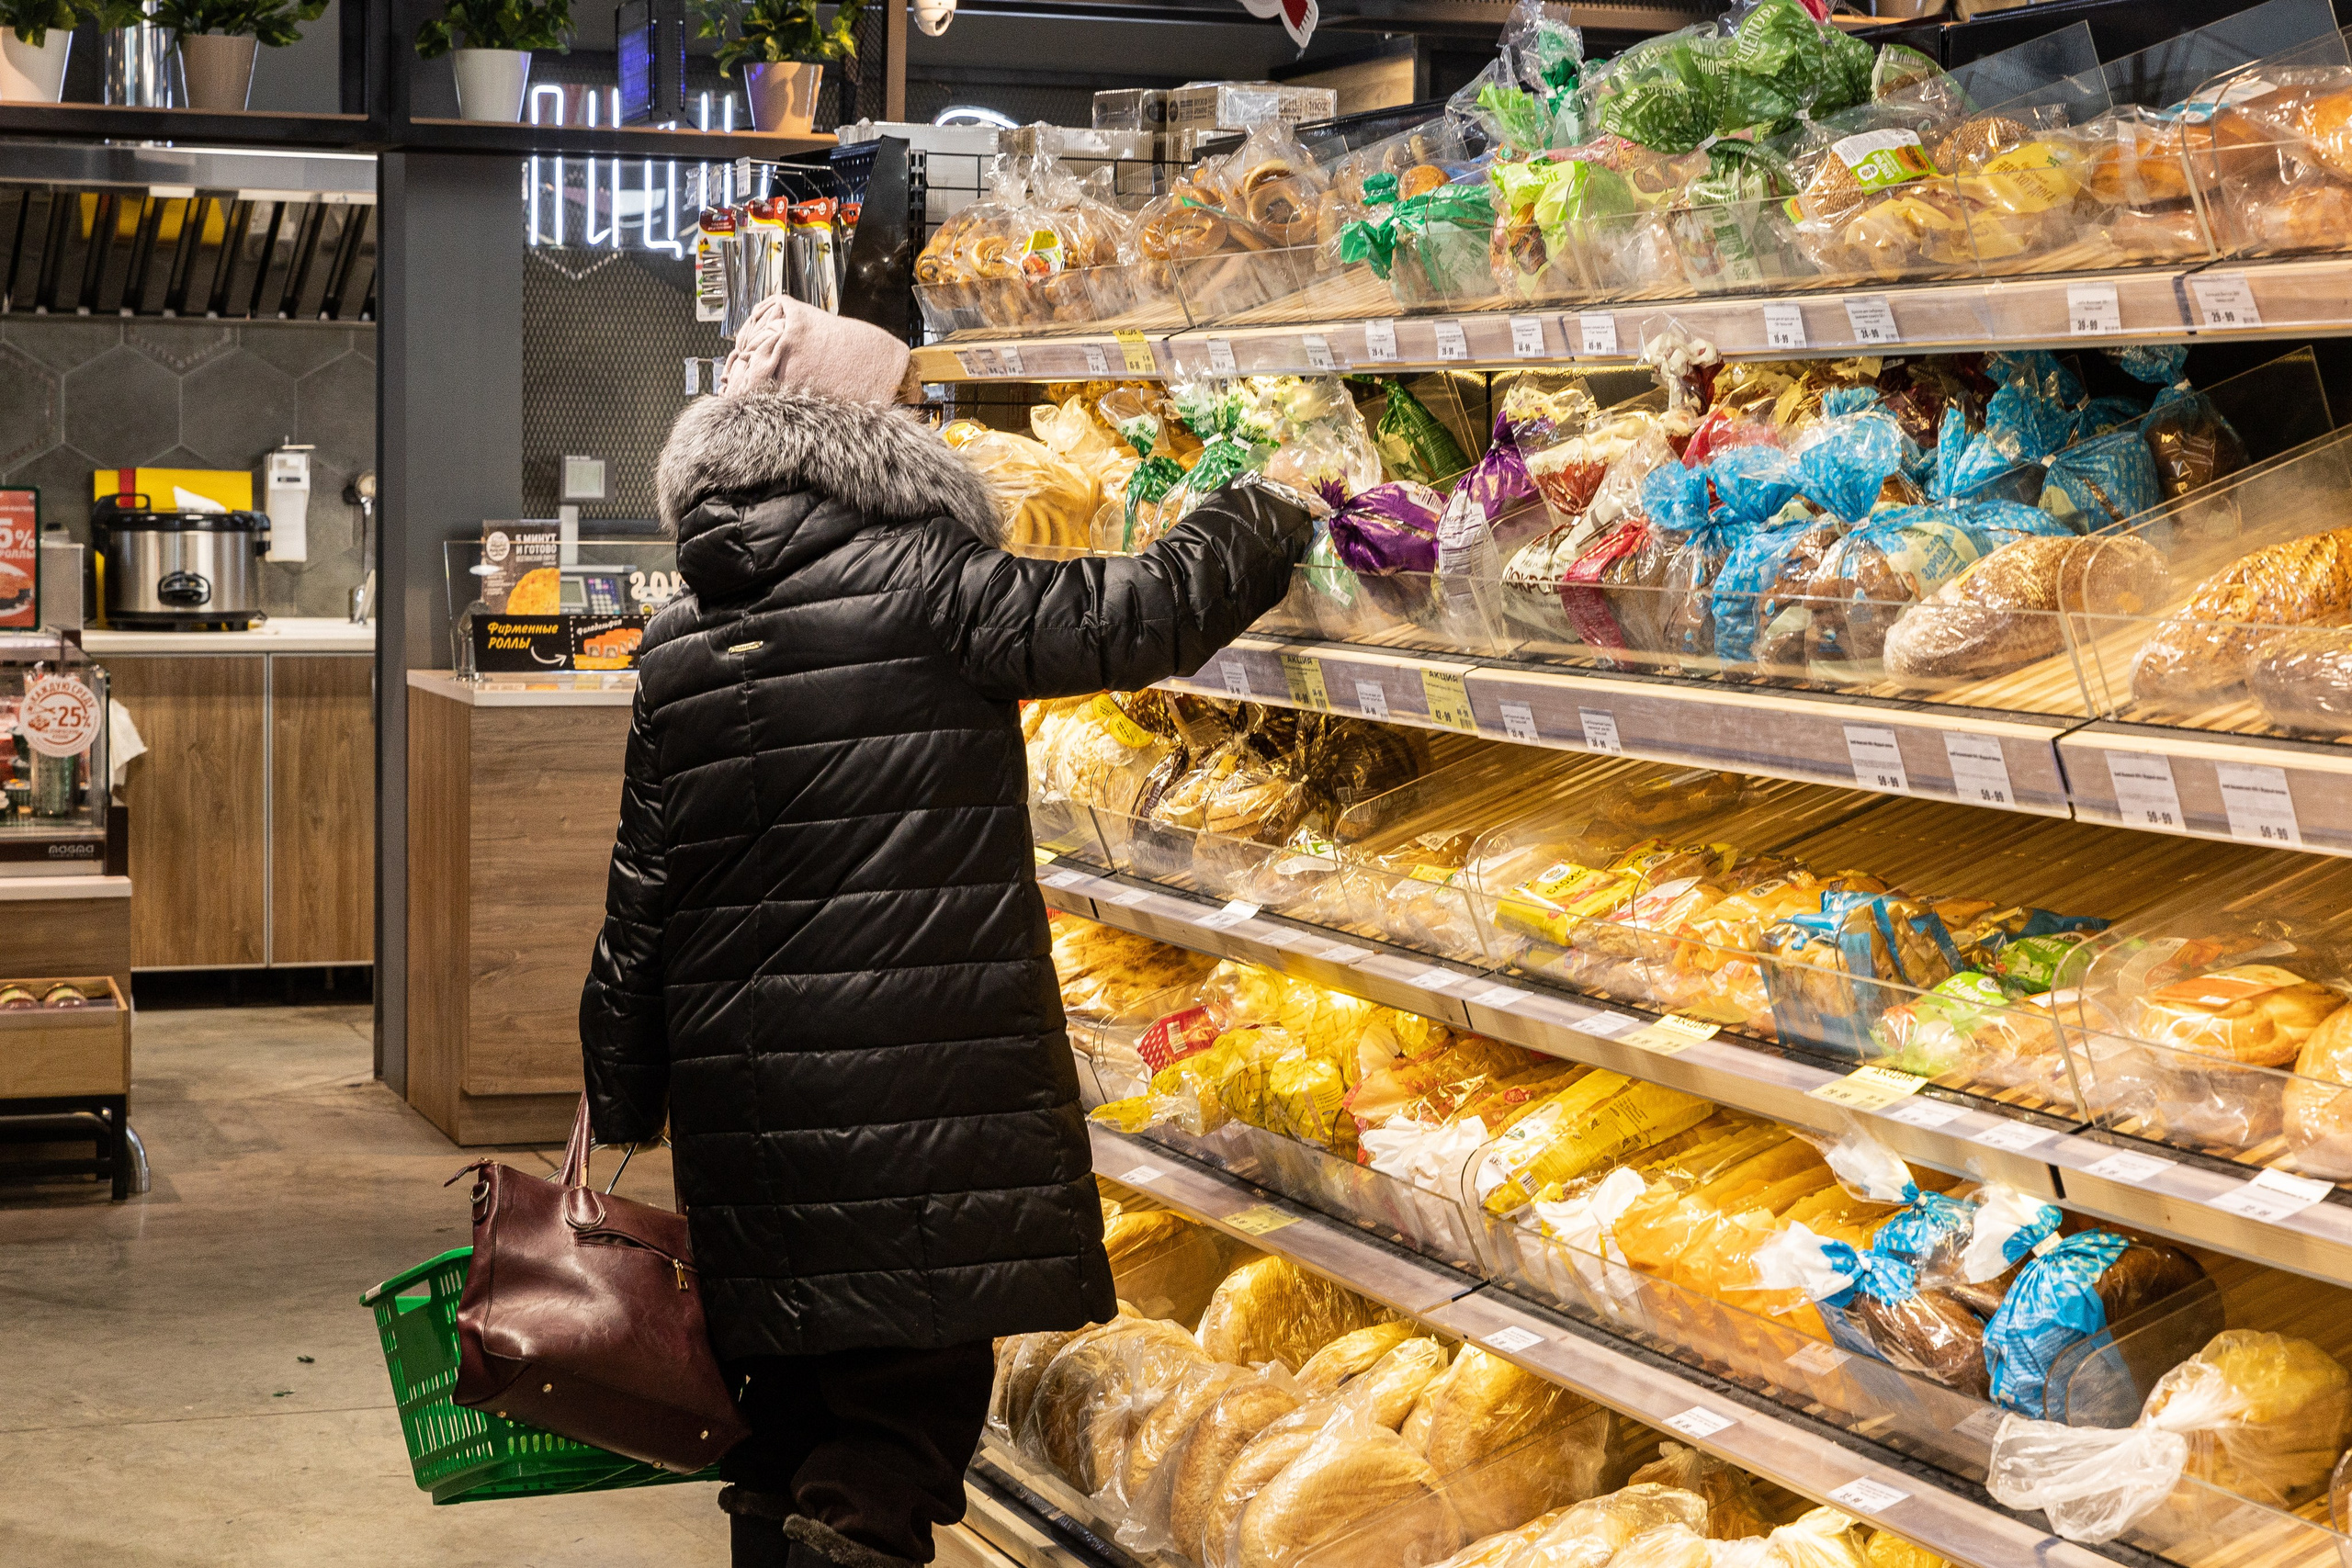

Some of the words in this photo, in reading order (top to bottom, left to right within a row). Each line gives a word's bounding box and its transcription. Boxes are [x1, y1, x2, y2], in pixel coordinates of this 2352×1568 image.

[530, 84, 776, 259] ПИЦ
[523, 533, 557, 544] МИНУТ
[516, 545, 523, 555] И
[524, 544, 558, 555] ГОТОВО
[487, 622, 559, 636] Фирменные
[488, 637, 531, 650] РОЛЛЫ
[1287, 655, 1313, 666] АКЦИЯ
[1429, 671, 1458, 683] АКЦИЯ
[52, 705, 91, 728] -25%
[2146, 810, 2173, 825] 59-99
[2260, 825, 2289, 840] 59-99
